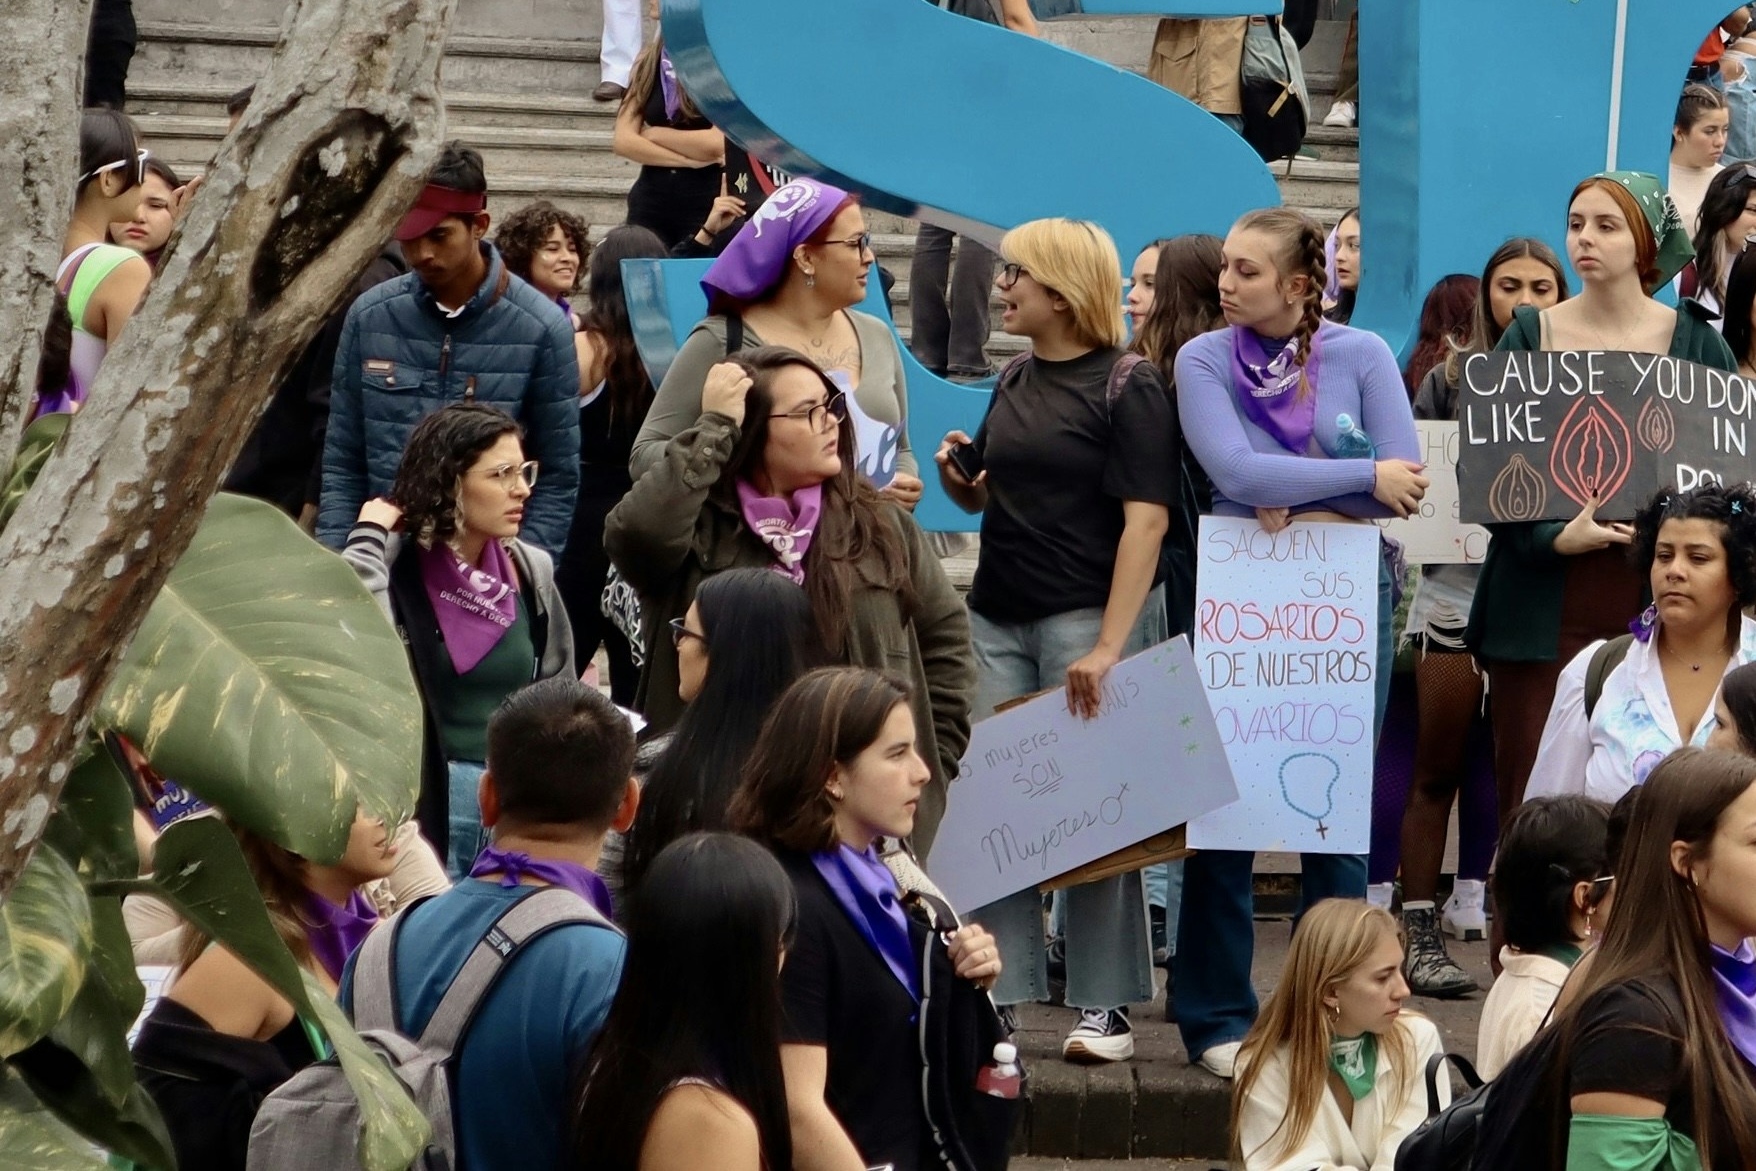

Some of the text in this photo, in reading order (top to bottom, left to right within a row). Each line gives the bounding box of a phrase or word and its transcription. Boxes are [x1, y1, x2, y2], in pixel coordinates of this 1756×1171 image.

[1464, 350, 1605, 397] CAUSE
[1628, 352, 1695, 405] YOU
[1466, 399, 1747, 457] LIKE IN
[1207, 528, 1327, 563] SAQUEN
[1301, 571, 1354, 600] SUS
[1199, 598, 1365, 645] ROSARIOS
[1206, 648, 1372, 690] DE NUESTROS
[1214, 701, 1365, 745] OVARIOS
[984, 728, 1060, 772] mujeres
[1012, 756, 1062, 796] SON
[980, 809, 1098, 875] Mujeres
